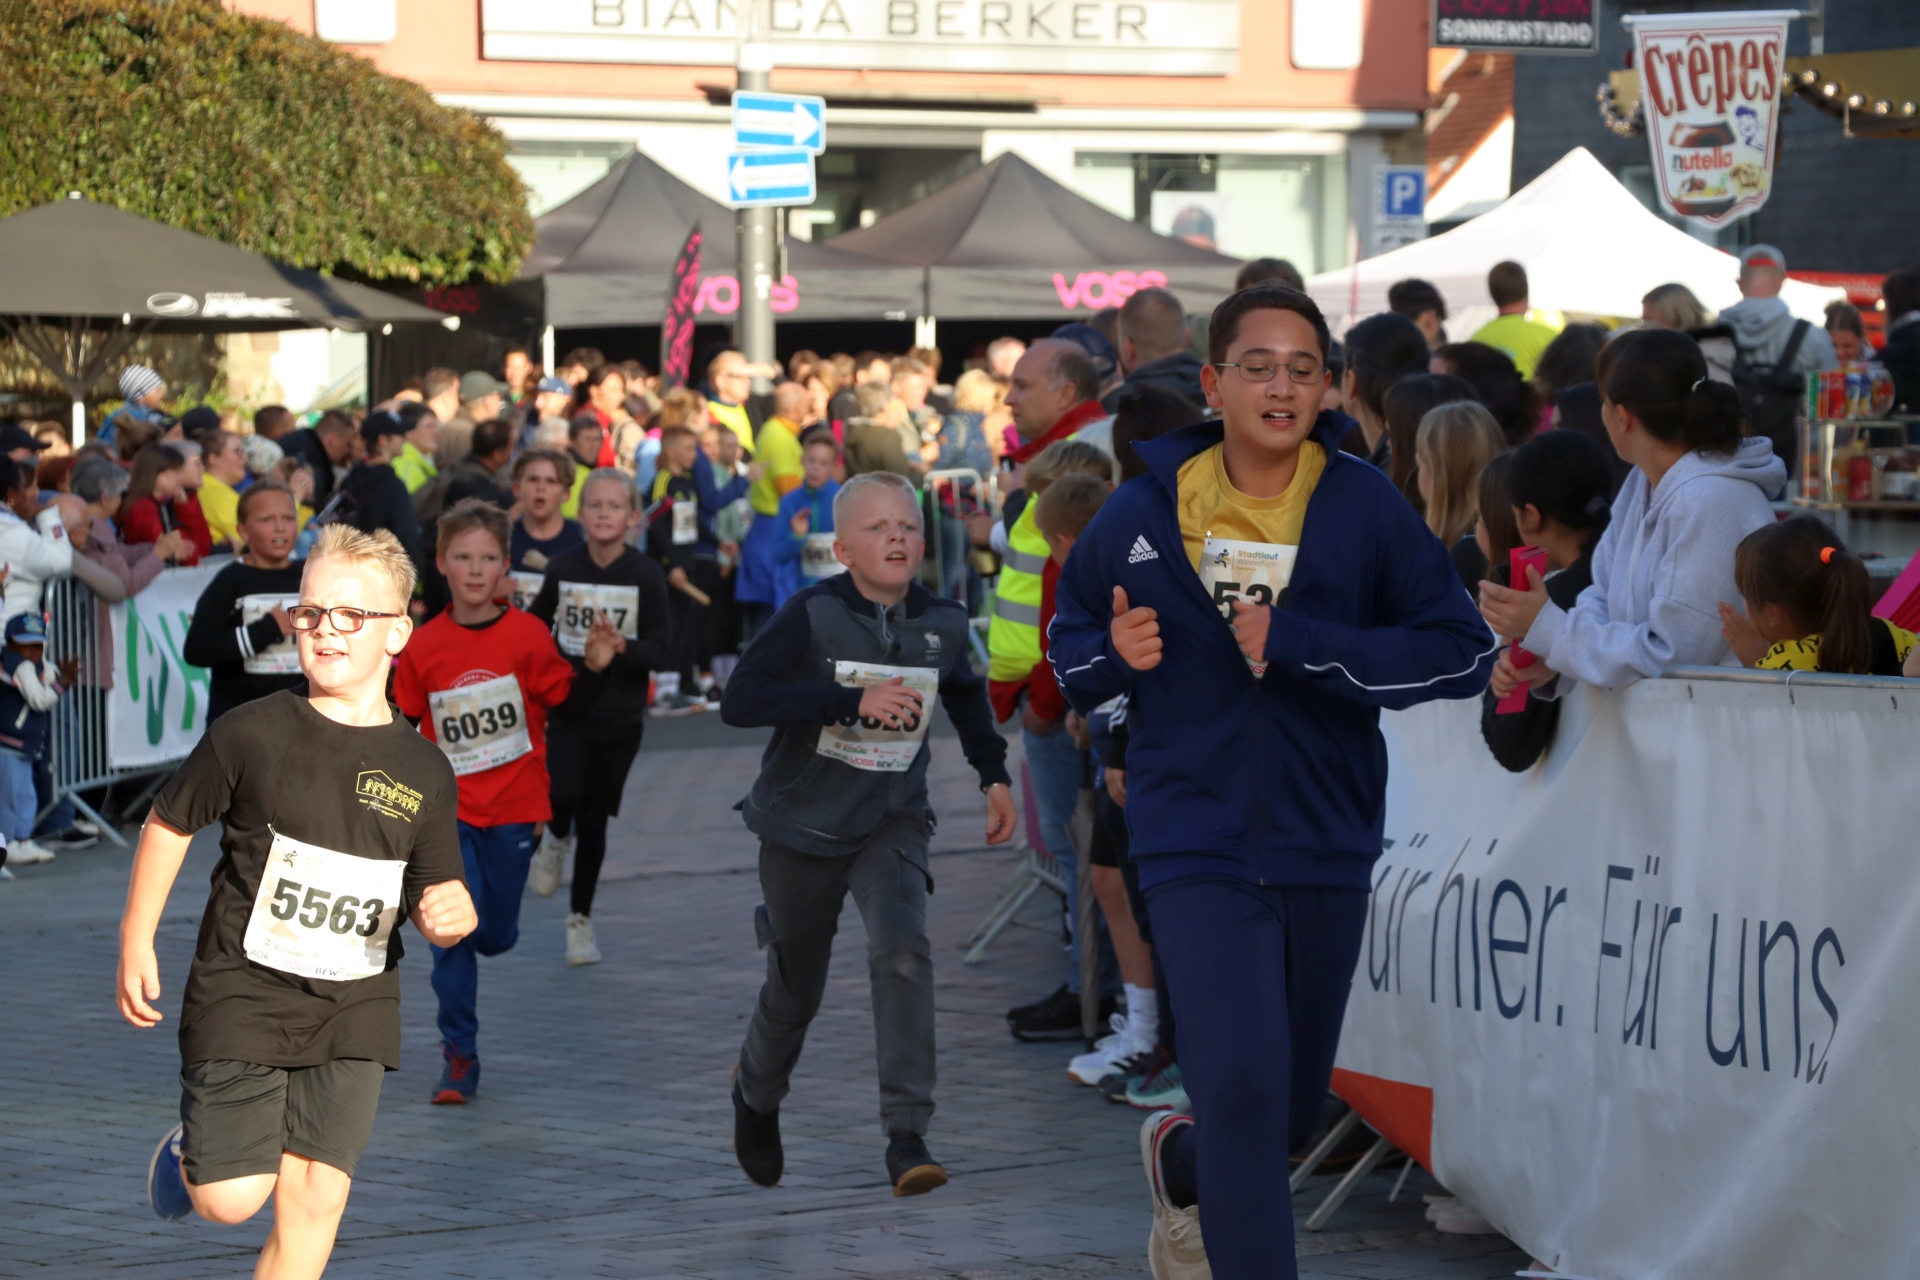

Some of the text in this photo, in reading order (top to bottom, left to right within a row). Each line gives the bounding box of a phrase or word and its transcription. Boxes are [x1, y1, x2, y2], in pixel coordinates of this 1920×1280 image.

[887, 0, 1148, 40] BERKER
[1437, 17, 1594, 47] SONNENSTUDIO
[1643, 31, 1780, 117] Crêpes
[1672, 146, 1734, 172] nutella
[1392, 175, 1417, 211] P
[692, 274, 800, 314] VOS
[1128, 550, 1159, 564] adidas
[1236, 557, 1279, 568] Wipperfürth
[1237, 549, 1279, 560] Stadtlauf
[566, 604, 628, 629] 587
[441, 701, 517, 743] 6039
[850, 756, 875, 767] VOSS
[876, 760, 893, 768] BEW
[270, 877, 385, 937] 5563
[315, 967, 340, 977] BEW
[1369, 832, 1846, 1085] ür hier. Für uns.
